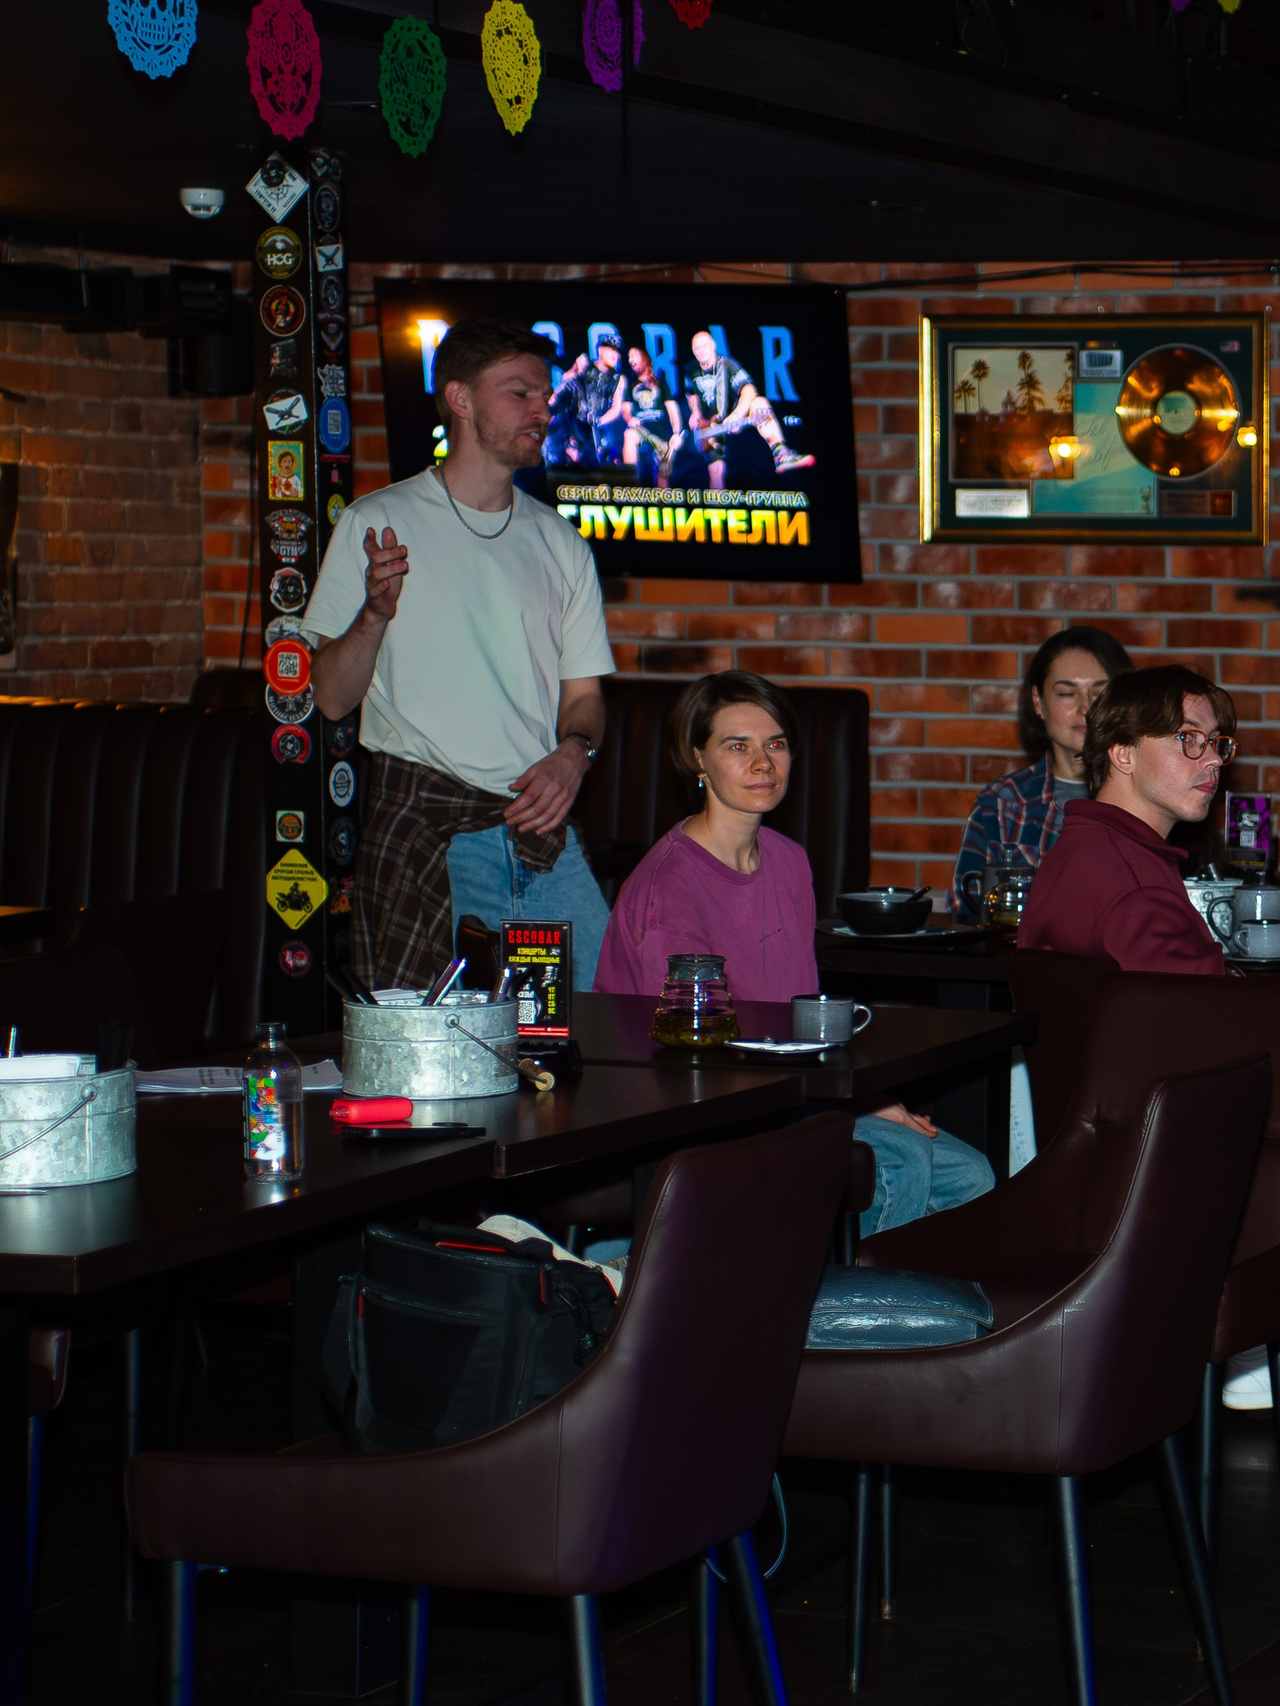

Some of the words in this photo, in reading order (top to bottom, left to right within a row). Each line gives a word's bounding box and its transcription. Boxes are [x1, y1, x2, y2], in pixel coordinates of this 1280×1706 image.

[556, 484, 610, 501] СЕРГЕЙ
[612, 487, 685, 504] ЗАХАРОВ
[686, 489, 700, 505] И
[703, 490, 809, 508] ШОУ-ГРУППА
[508, 929, 561, 945] ESCOBAR
[517, 947, 546, 956] КОНЦЕРТЫ
[508, 956, 531, 964] КАЖДЫЕ
[531, 956, 561, 964] ВЫХОДНЫЕ
